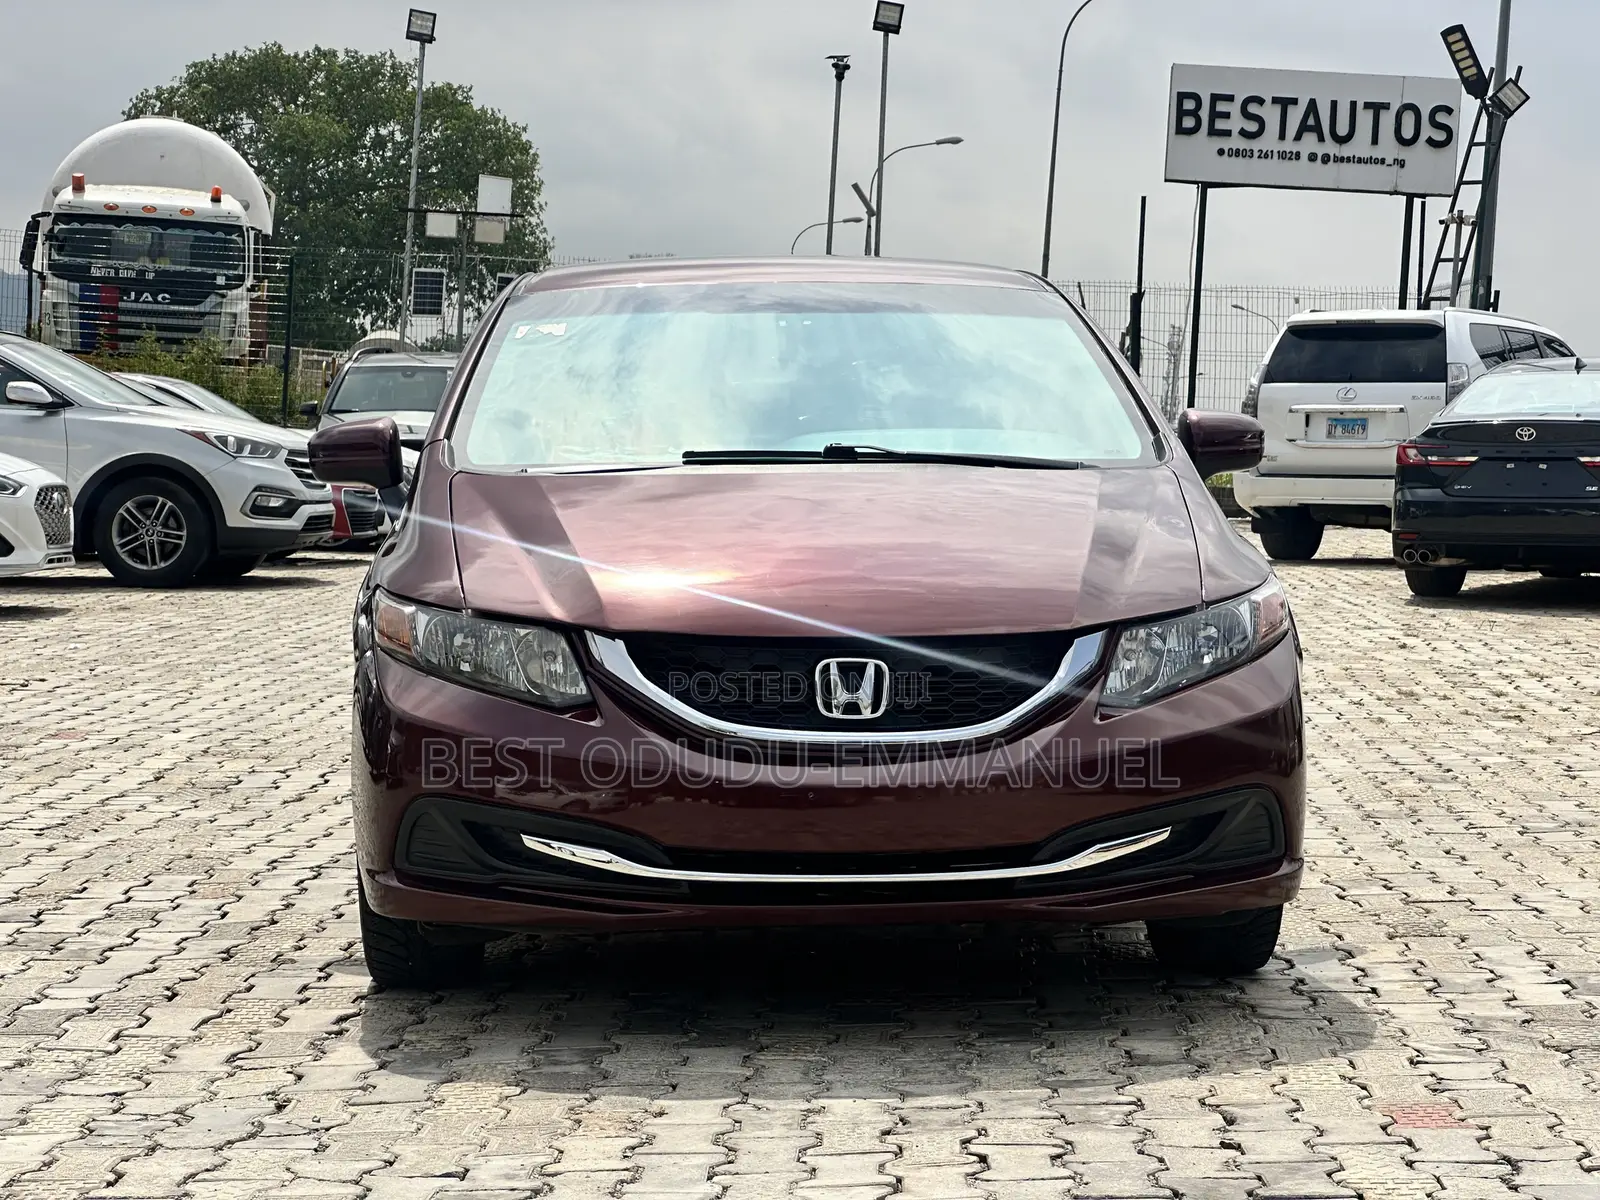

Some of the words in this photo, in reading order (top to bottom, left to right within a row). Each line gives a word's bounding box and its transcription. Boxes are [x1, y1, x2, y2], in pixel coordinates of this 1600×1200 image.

[1175, 91, 1455, 148] BESTAUTOS
[1227, 147, 1254, 158] 0803
[1257, 149, 1274, 160] 261
[1277, 150, 1301, 161] 1028
[1320, 153, 1406, 168] @bestautos_ng
[90, 266, 115, 277] NEVER
[123, 291, 172, 303] JAC
[1328, 423, 1337, 435] DY
[1341, 423, 1366, 435] 84679
